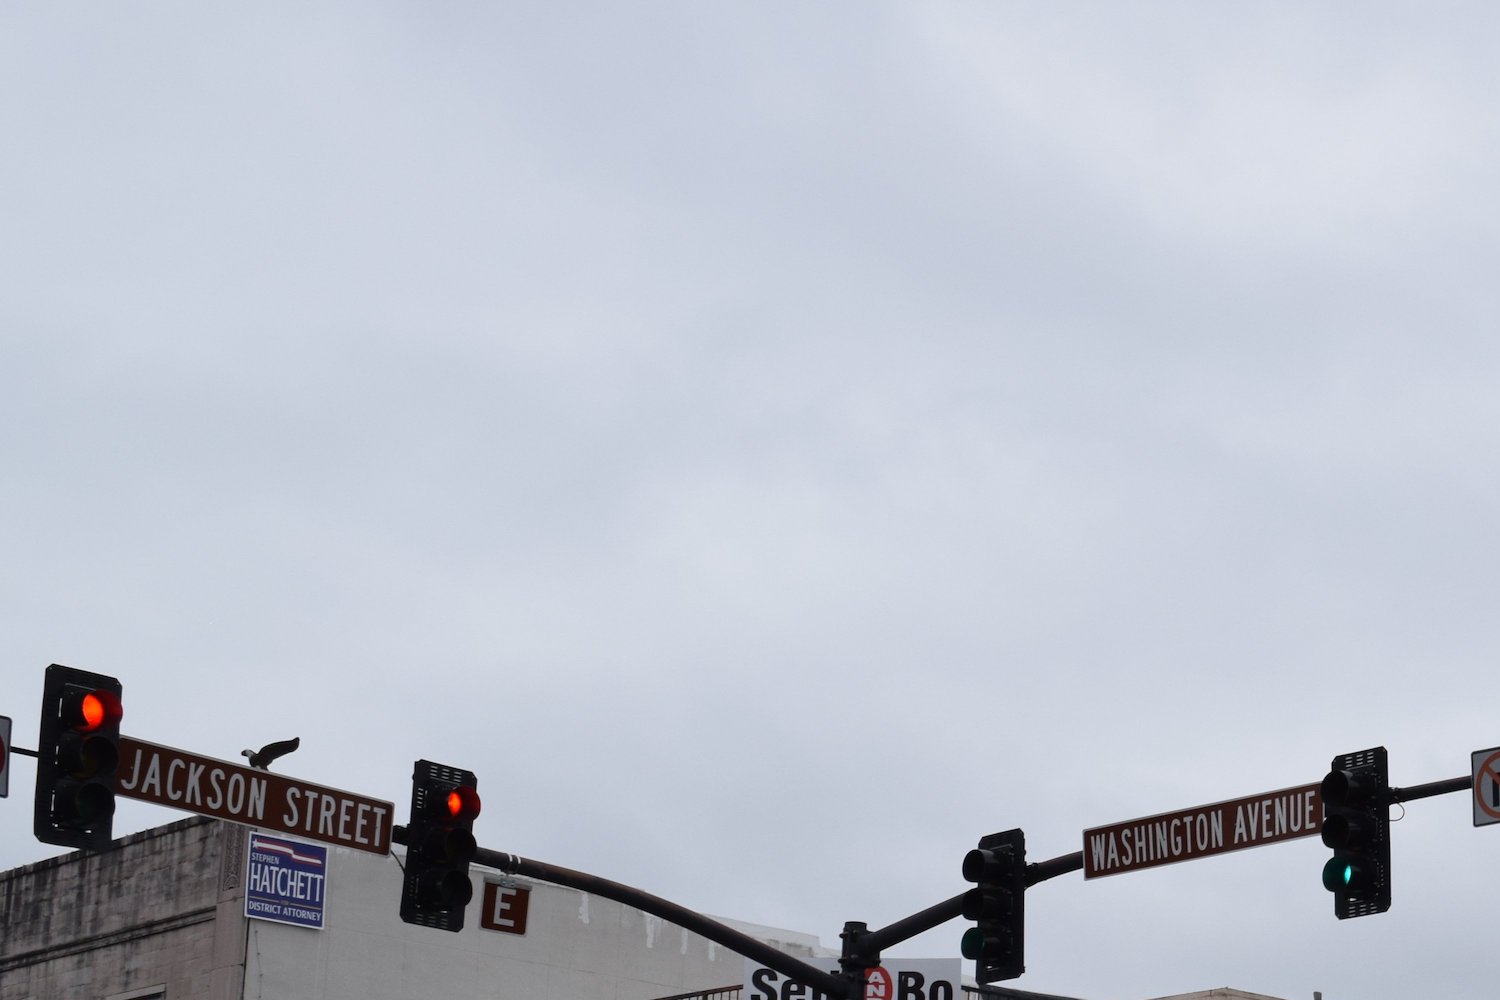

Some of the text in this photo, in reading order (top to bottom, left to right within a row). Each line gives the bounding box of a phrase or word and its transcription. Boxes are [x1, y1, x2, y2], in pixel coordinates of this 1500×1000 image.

[120, 749, 386, 847] JACKSON STREET
[1090, 790, 1316, 872] WASHINGTON AVENUE
[251, 852, 280, 865] STEPHEN
[249, 862, 324, 902] HATCHETT
[248, 901, 321, 921] DISTRICT ATTORNEY
[493, 886, 517, 927] E
